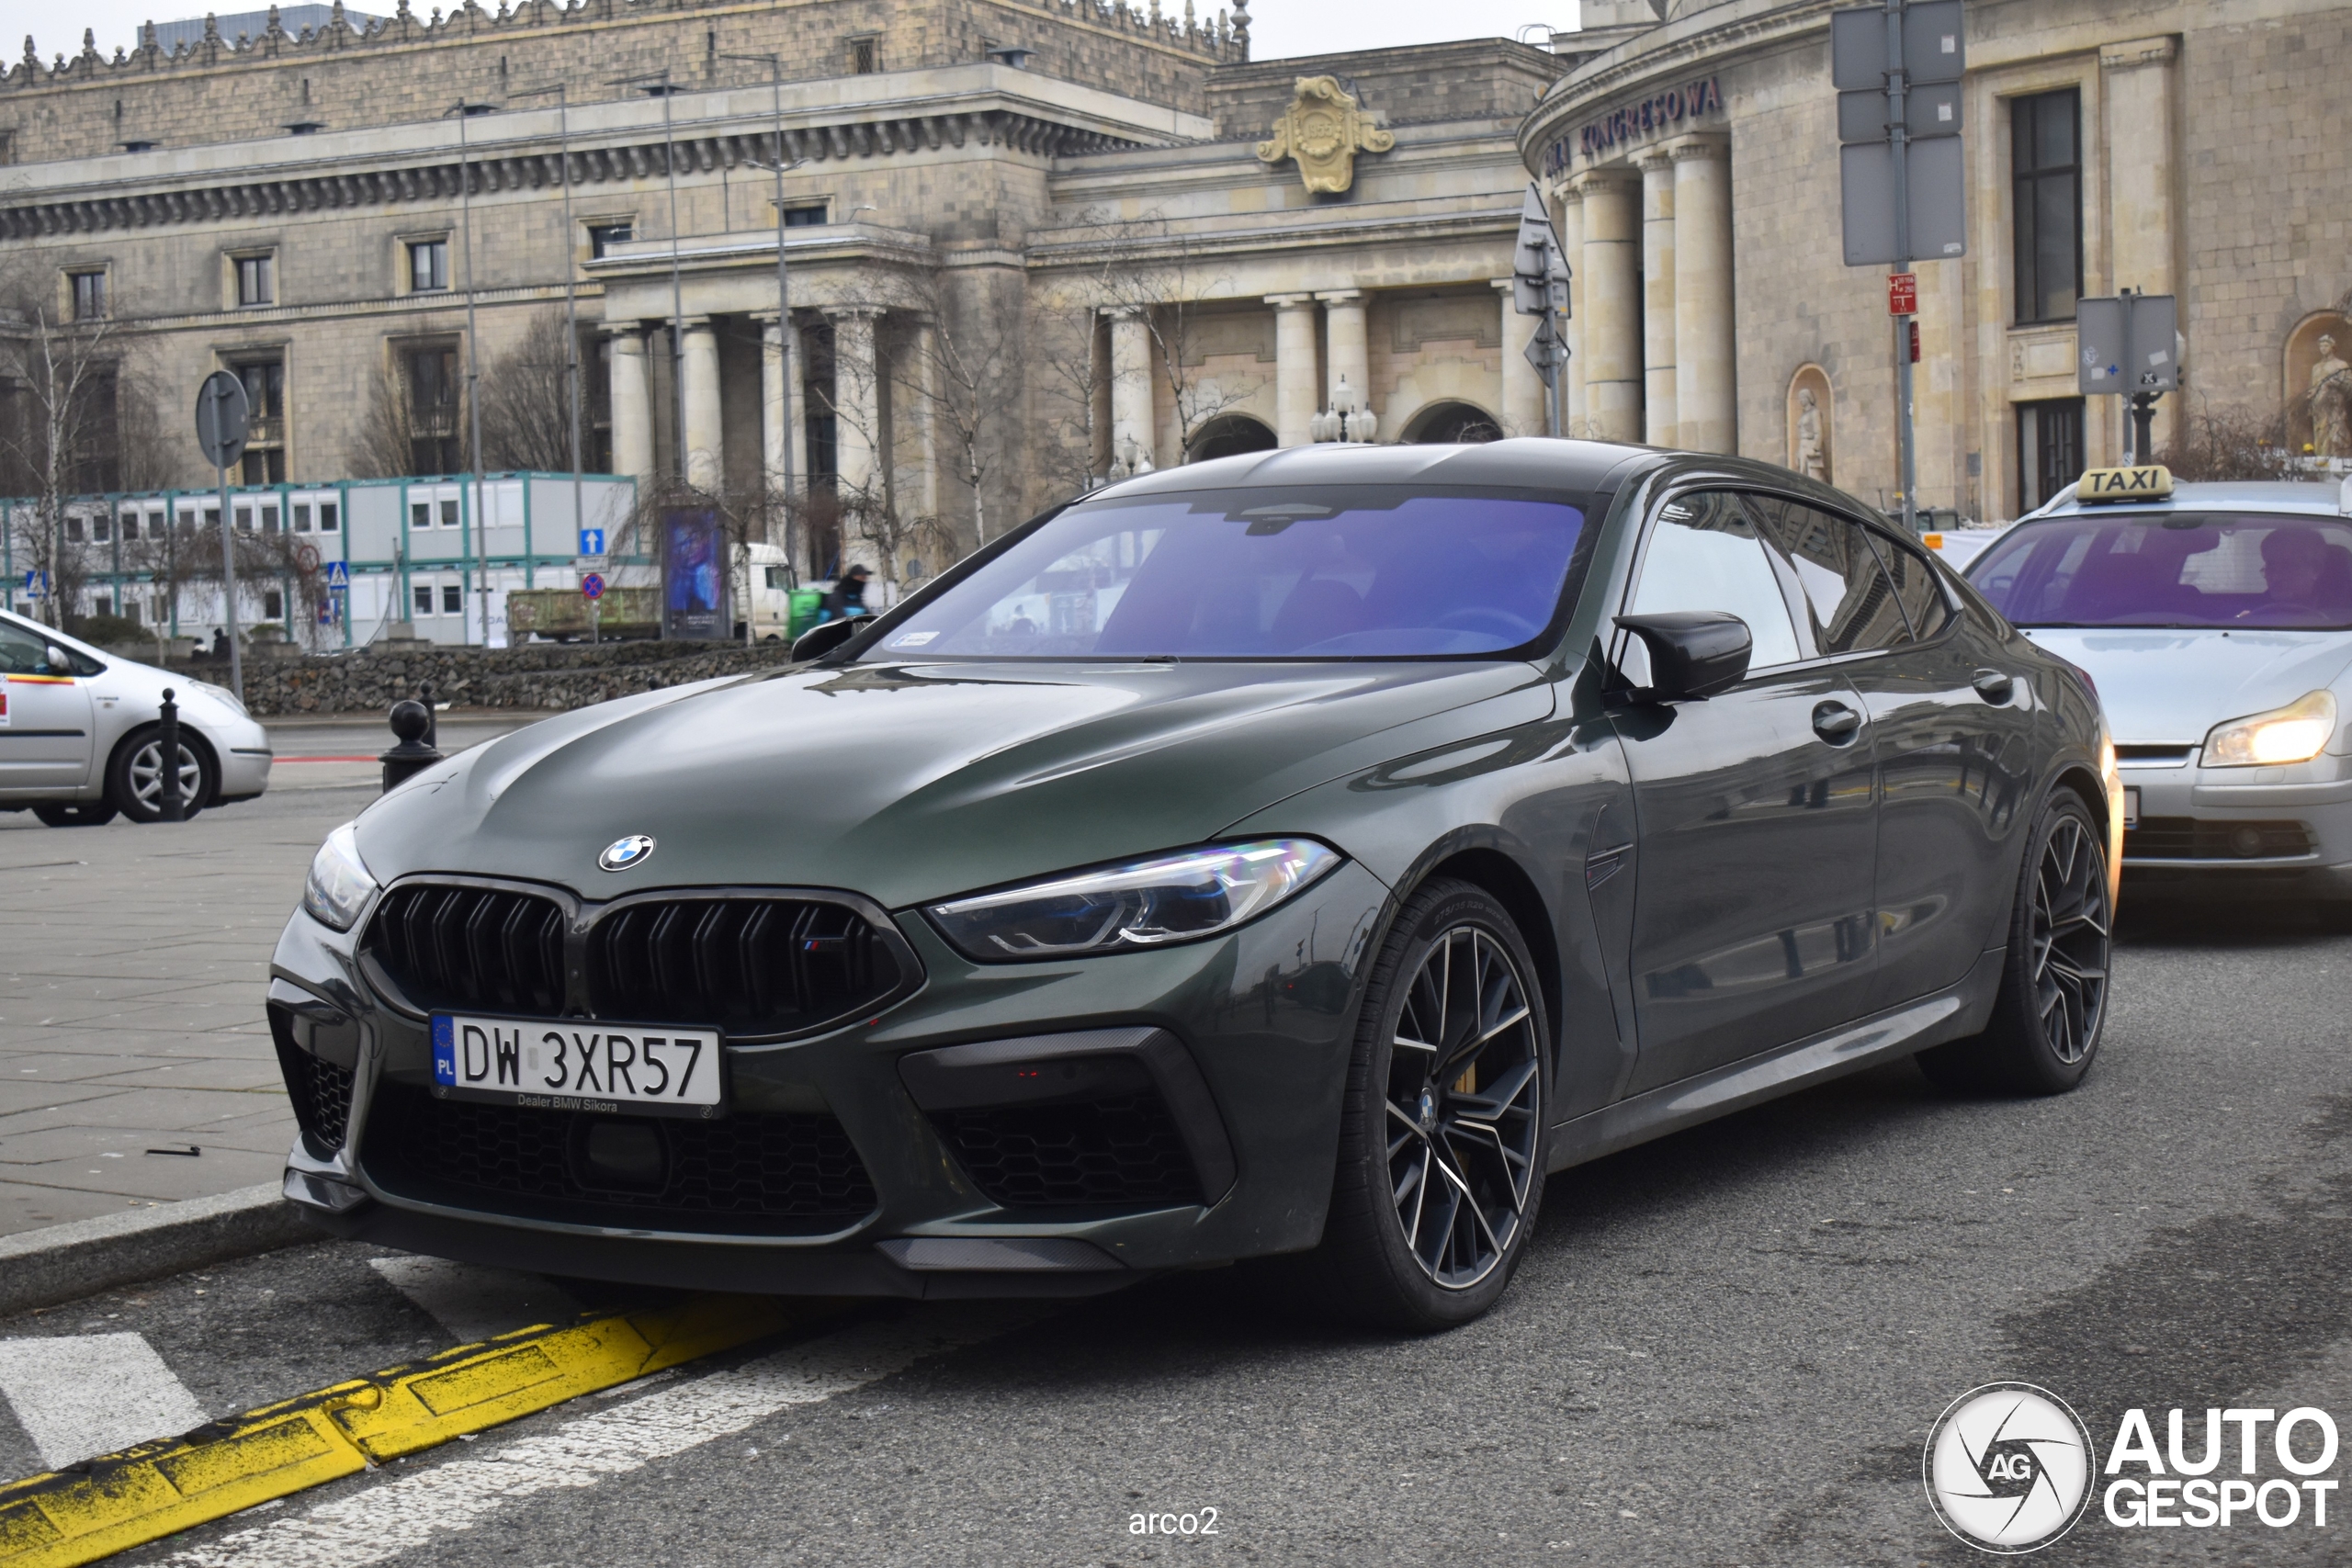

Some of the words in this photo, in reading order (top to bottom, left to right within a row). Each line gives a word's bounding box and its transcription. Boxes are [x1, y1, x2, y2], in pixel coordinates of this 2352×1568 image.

[1579, 76, 1723, 155] KONGRESOWA
[1307, 123, 1333, 139] 1955
[2089, 469, 2158, 492] TAXI
[1434, 900, 1466, 926] 275/35
[1466, 900, 1484, 909] R20
[437, 1059, 454, 1076] PL
[462, 1024, 520, 1086] DW
[542, 1031, 703, 1097] 3XR57
[517, 1093, 551, 1108] Dealer
[553, 1096, 582, 1110] BMW
[583, 1098, 618, 1112] Sikora
